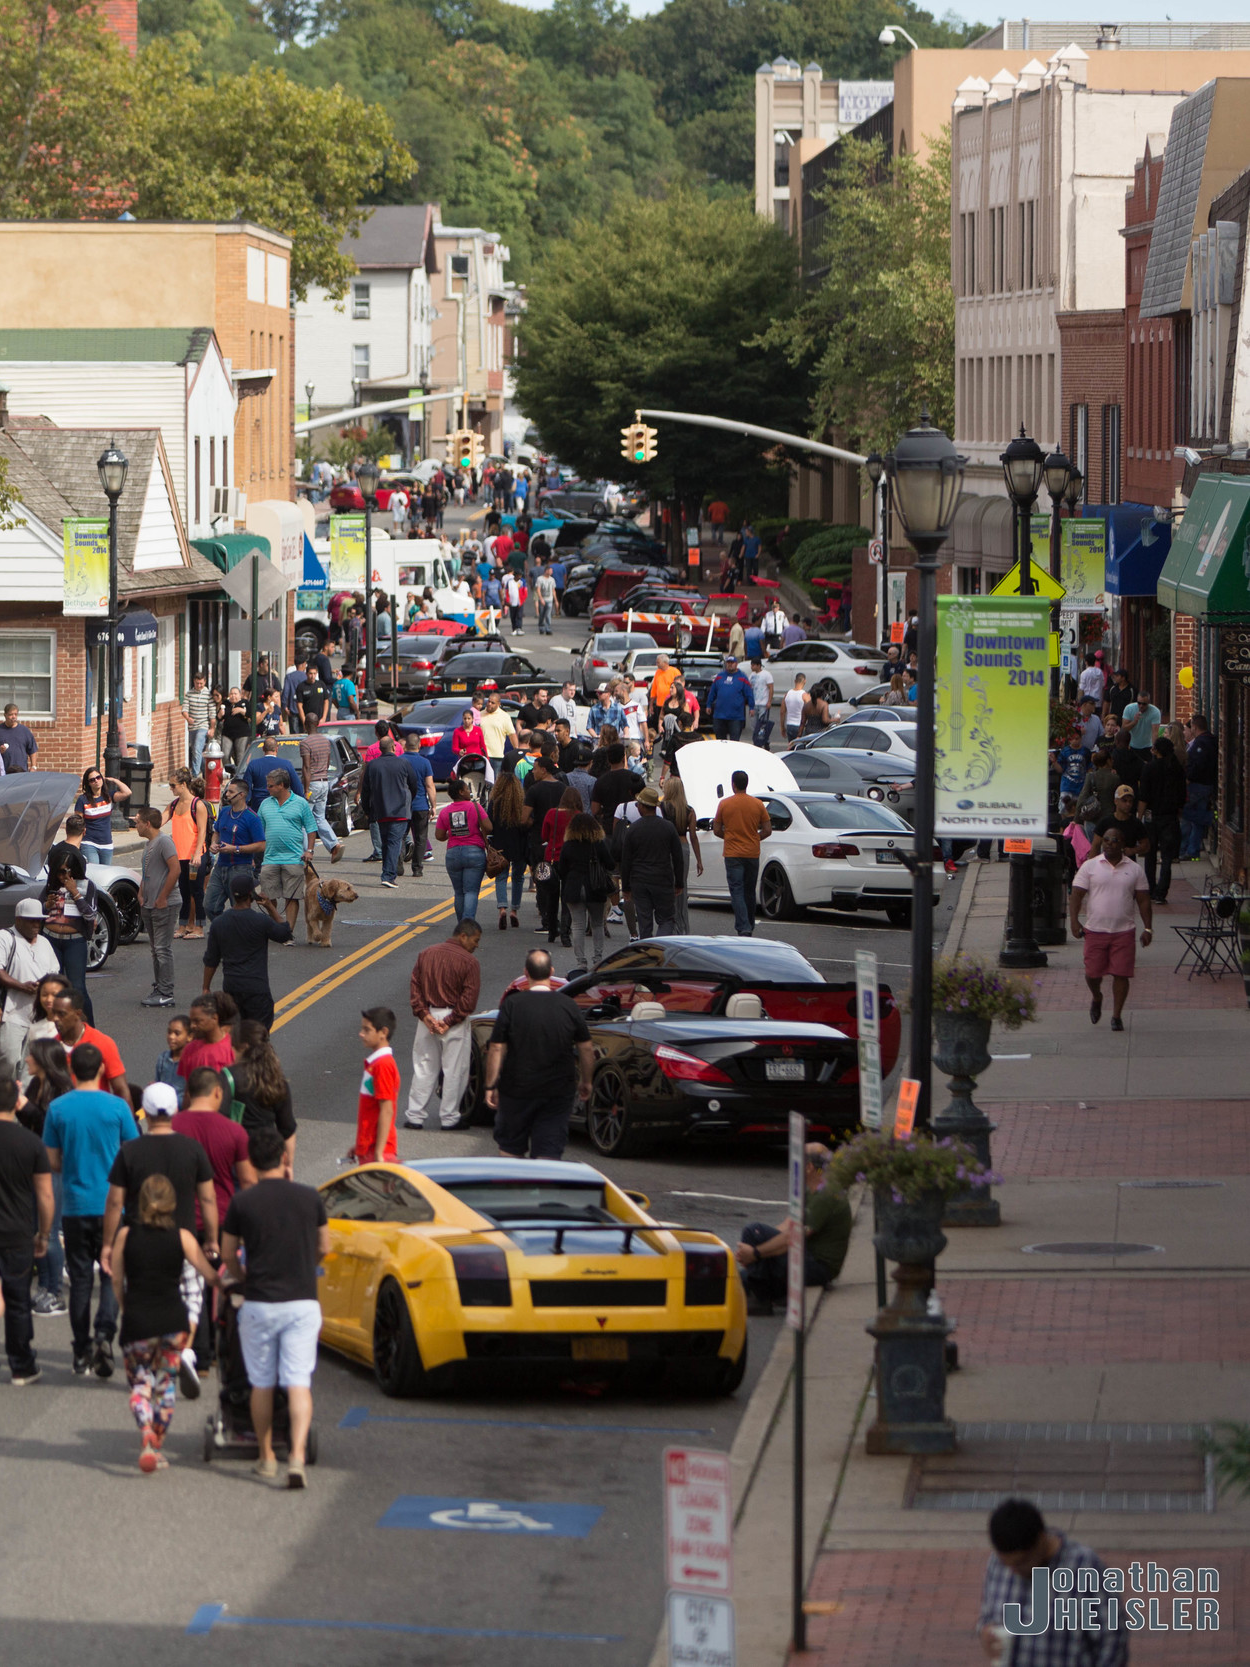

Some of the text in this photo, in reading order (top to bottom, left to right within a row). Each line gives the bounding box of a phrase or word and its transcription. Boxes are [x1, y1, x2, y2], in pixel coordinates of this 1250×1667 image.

[844, 96, 882, 109] NOW
[74, 539, 98, 547] Sounds
[92, 546, 107, 554] 2014
[1089, 546, 1104, 554] 2014
[964, 633, 1045, 650] Downtown
[964, 650, 1023, 668] Sounds
[1008, 669, 1044, 686] 2014
[977, 801, 1022, 809] SUBARU
[941, 816, 1038, 826] NORTH COAST
